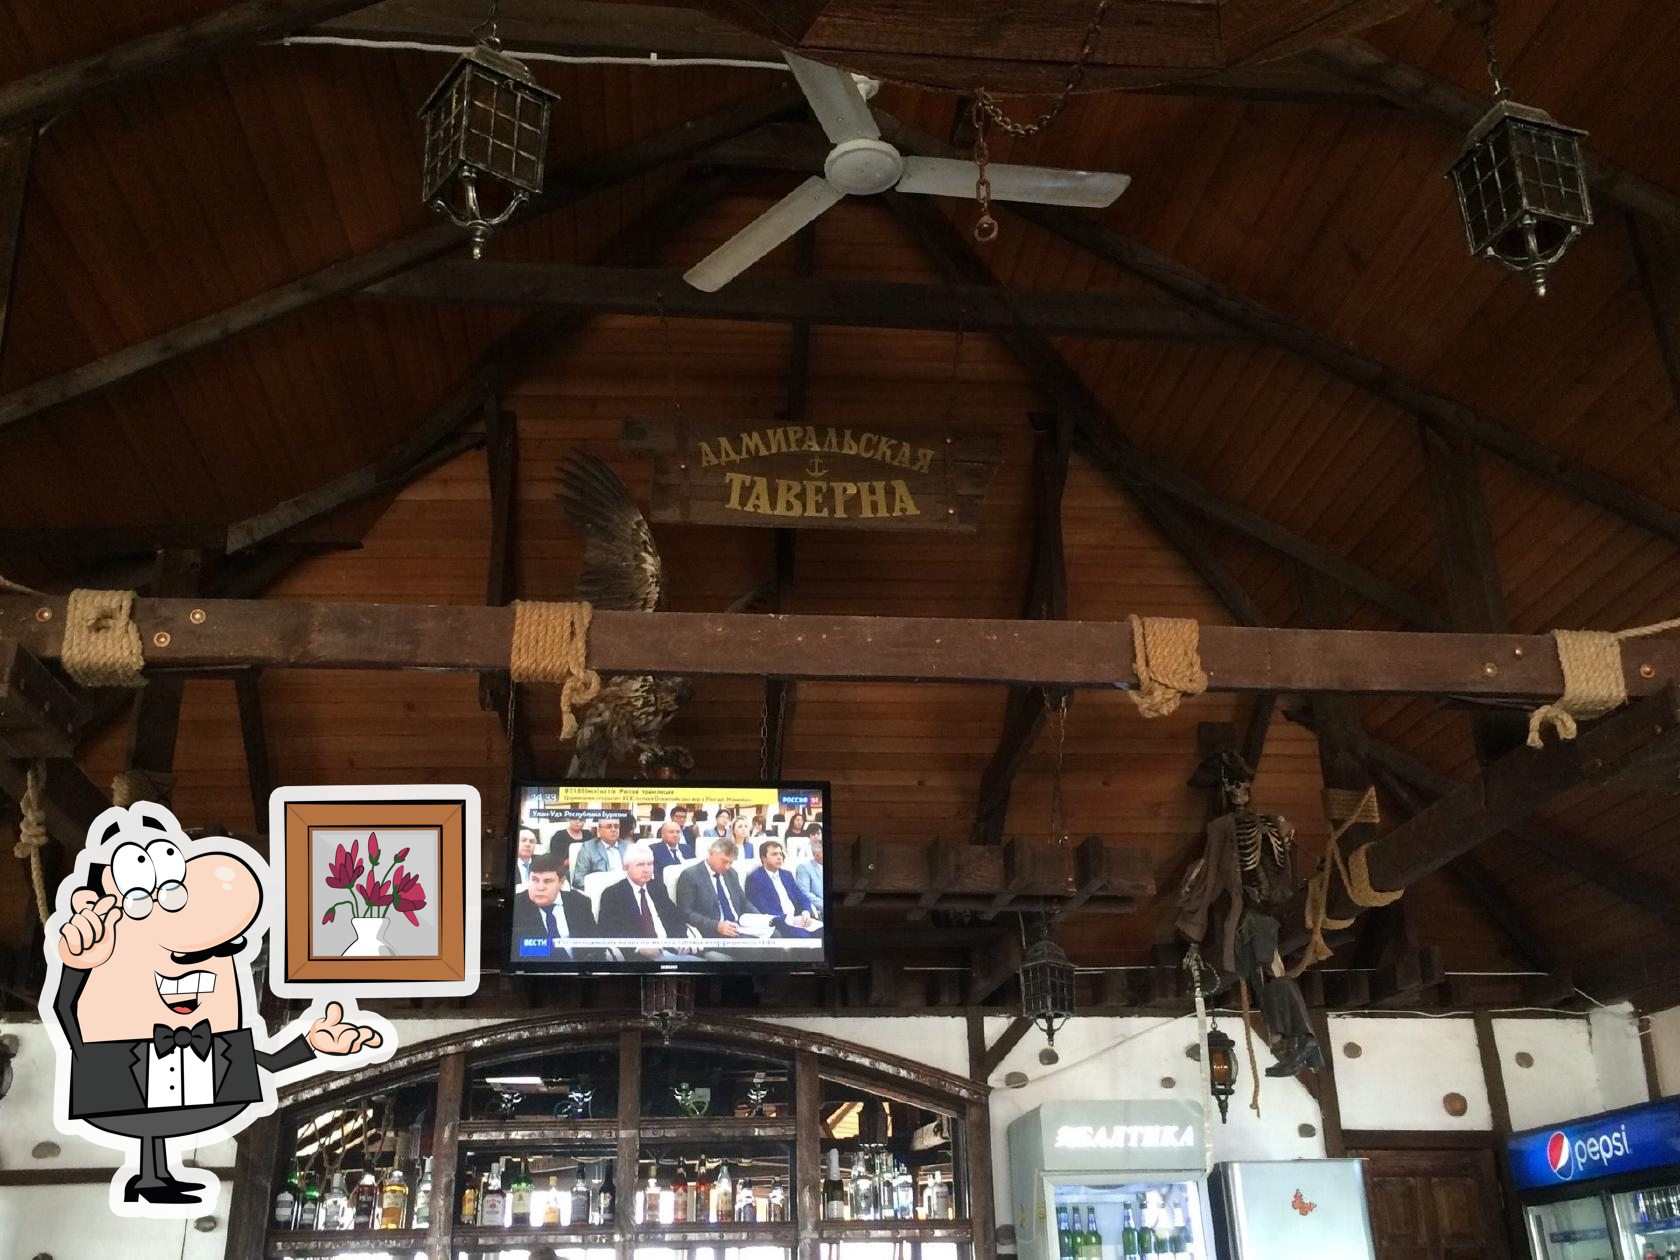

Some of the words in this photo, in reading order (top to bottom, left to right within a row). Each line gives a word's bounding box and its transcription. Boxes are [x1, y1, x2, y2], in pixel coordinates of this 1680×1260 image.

[697, 426, 935, 474] АДМИРАЛЬСКАЯ
[725, 472, 920, 518] ТАВЕРНА
[523, 938, 547, 947] ВЕСТИ
[1574, 1124, 1630, 1171] pepsi
